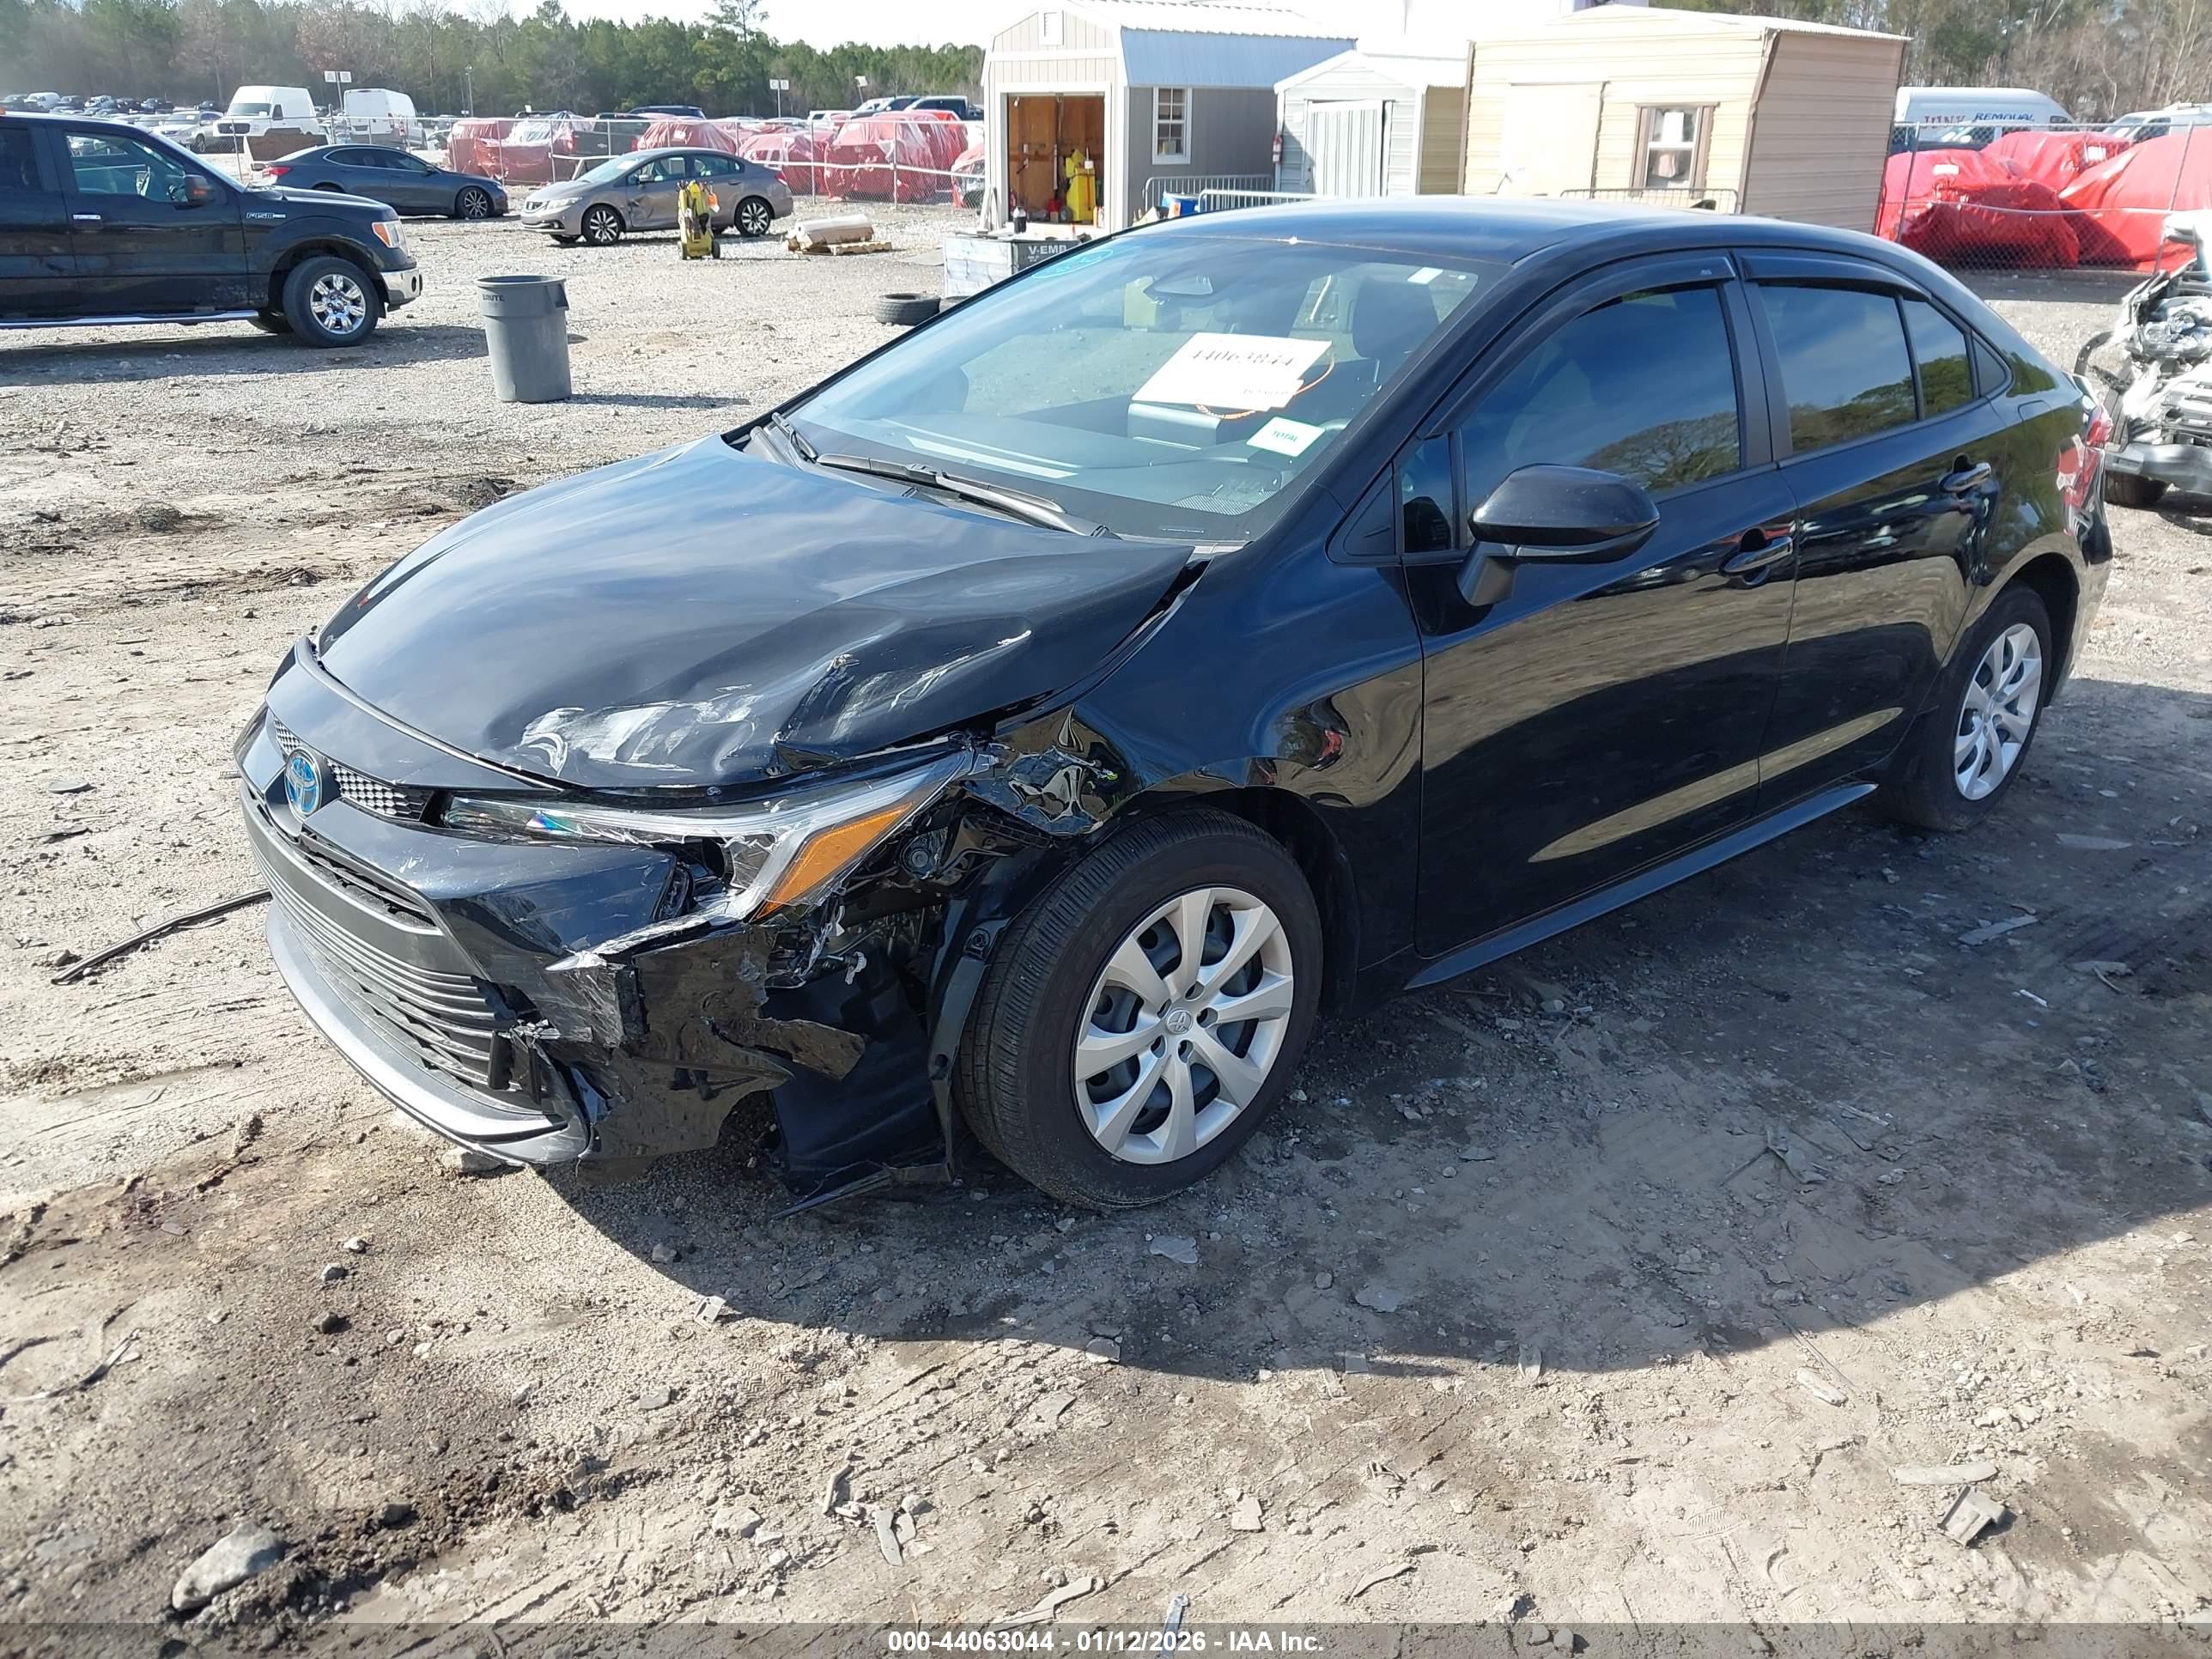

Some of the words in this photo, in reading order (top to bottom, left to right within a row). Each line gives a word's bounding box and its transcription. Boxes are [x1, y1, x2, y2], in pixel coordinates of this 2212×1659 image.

[1972, 112, 2035, 122] REMOVAL
[482, 294, 505, 302] BRUTE
[1271, 429, 1298, 442] TOTAL
